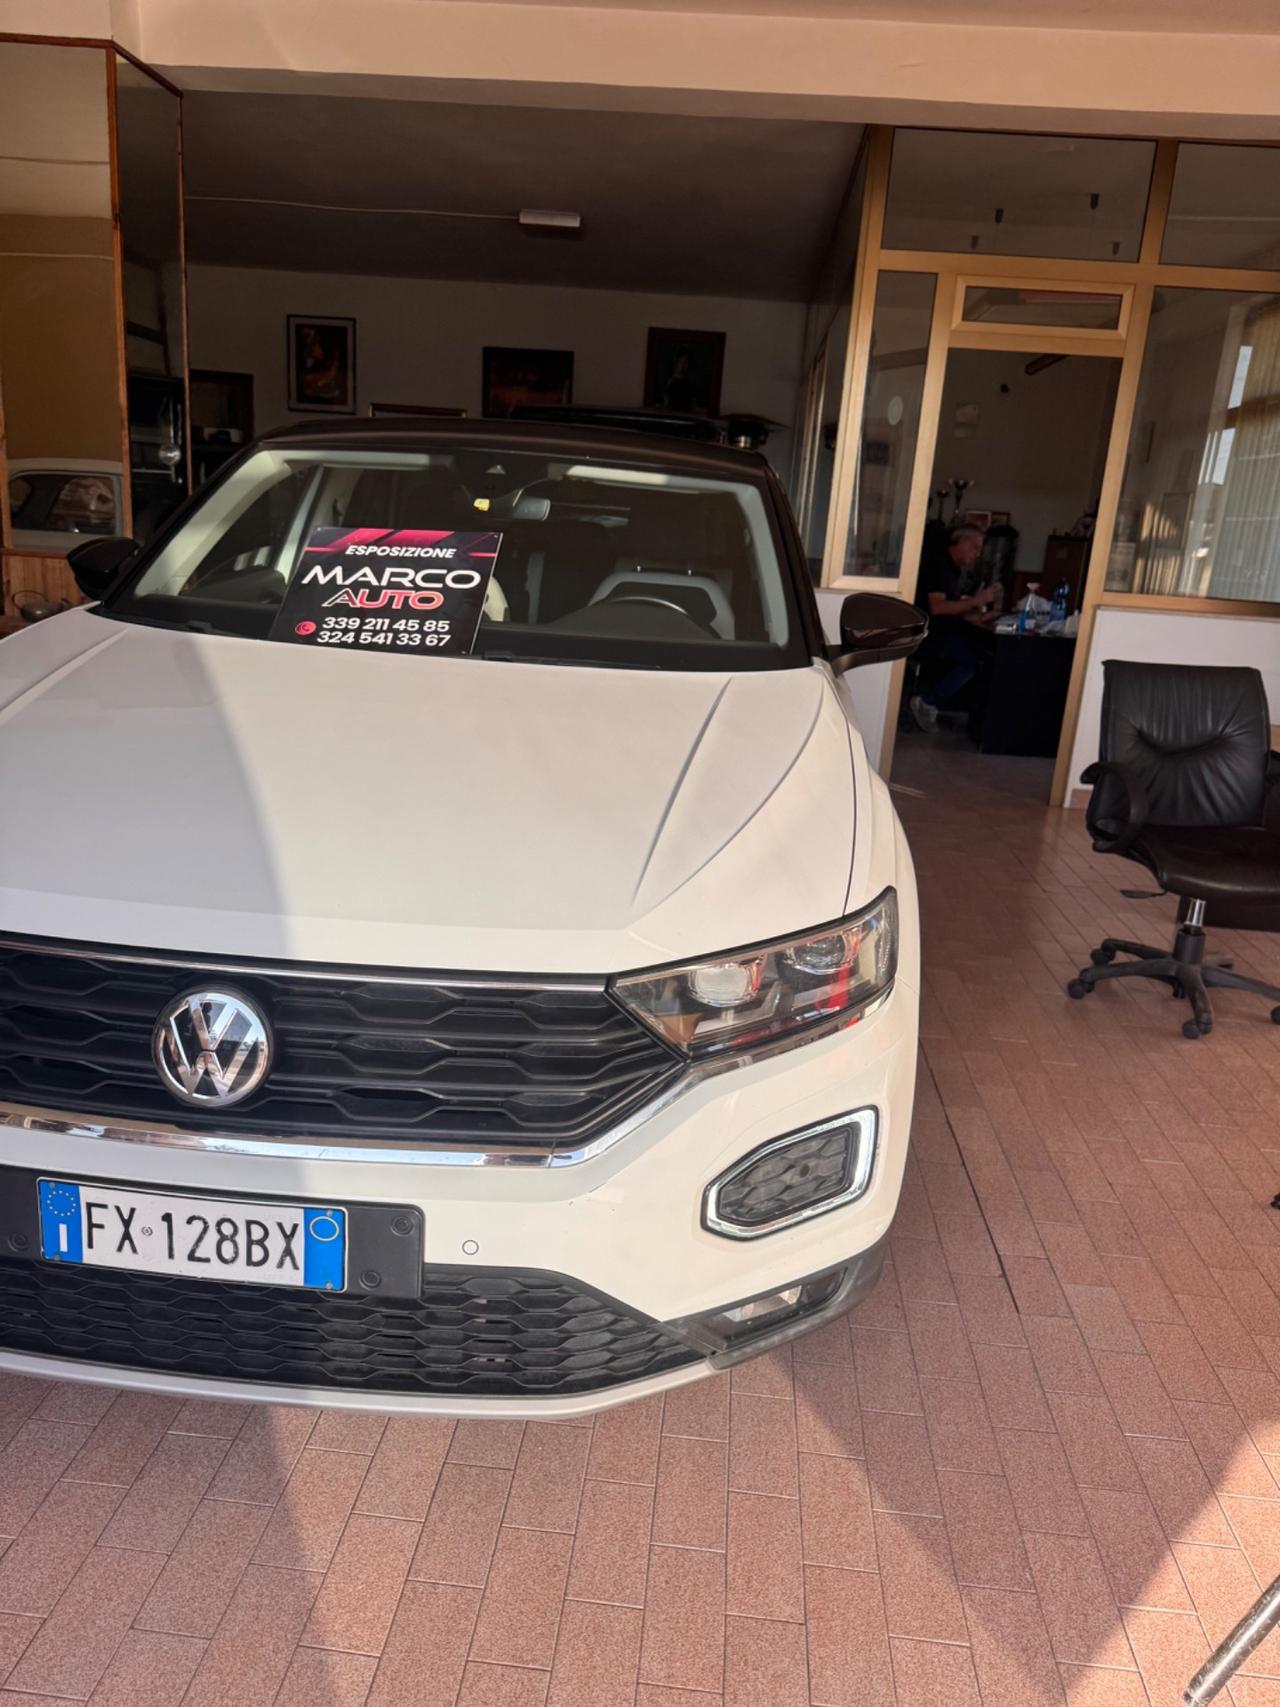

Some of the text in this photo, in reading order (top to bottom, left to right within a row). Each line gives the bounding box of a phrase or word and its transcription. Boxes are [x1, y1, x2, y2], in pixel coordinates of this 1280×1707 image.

[345, 545, 457, 558] ESPOSIZIONE
[301, 565, 481, 589] MARCO
[321, 588, 444, 610] AUTO
[322, 617, 450, 632] 339 211 45 85
[317, 631, 451, 647] 324 541 33 67
